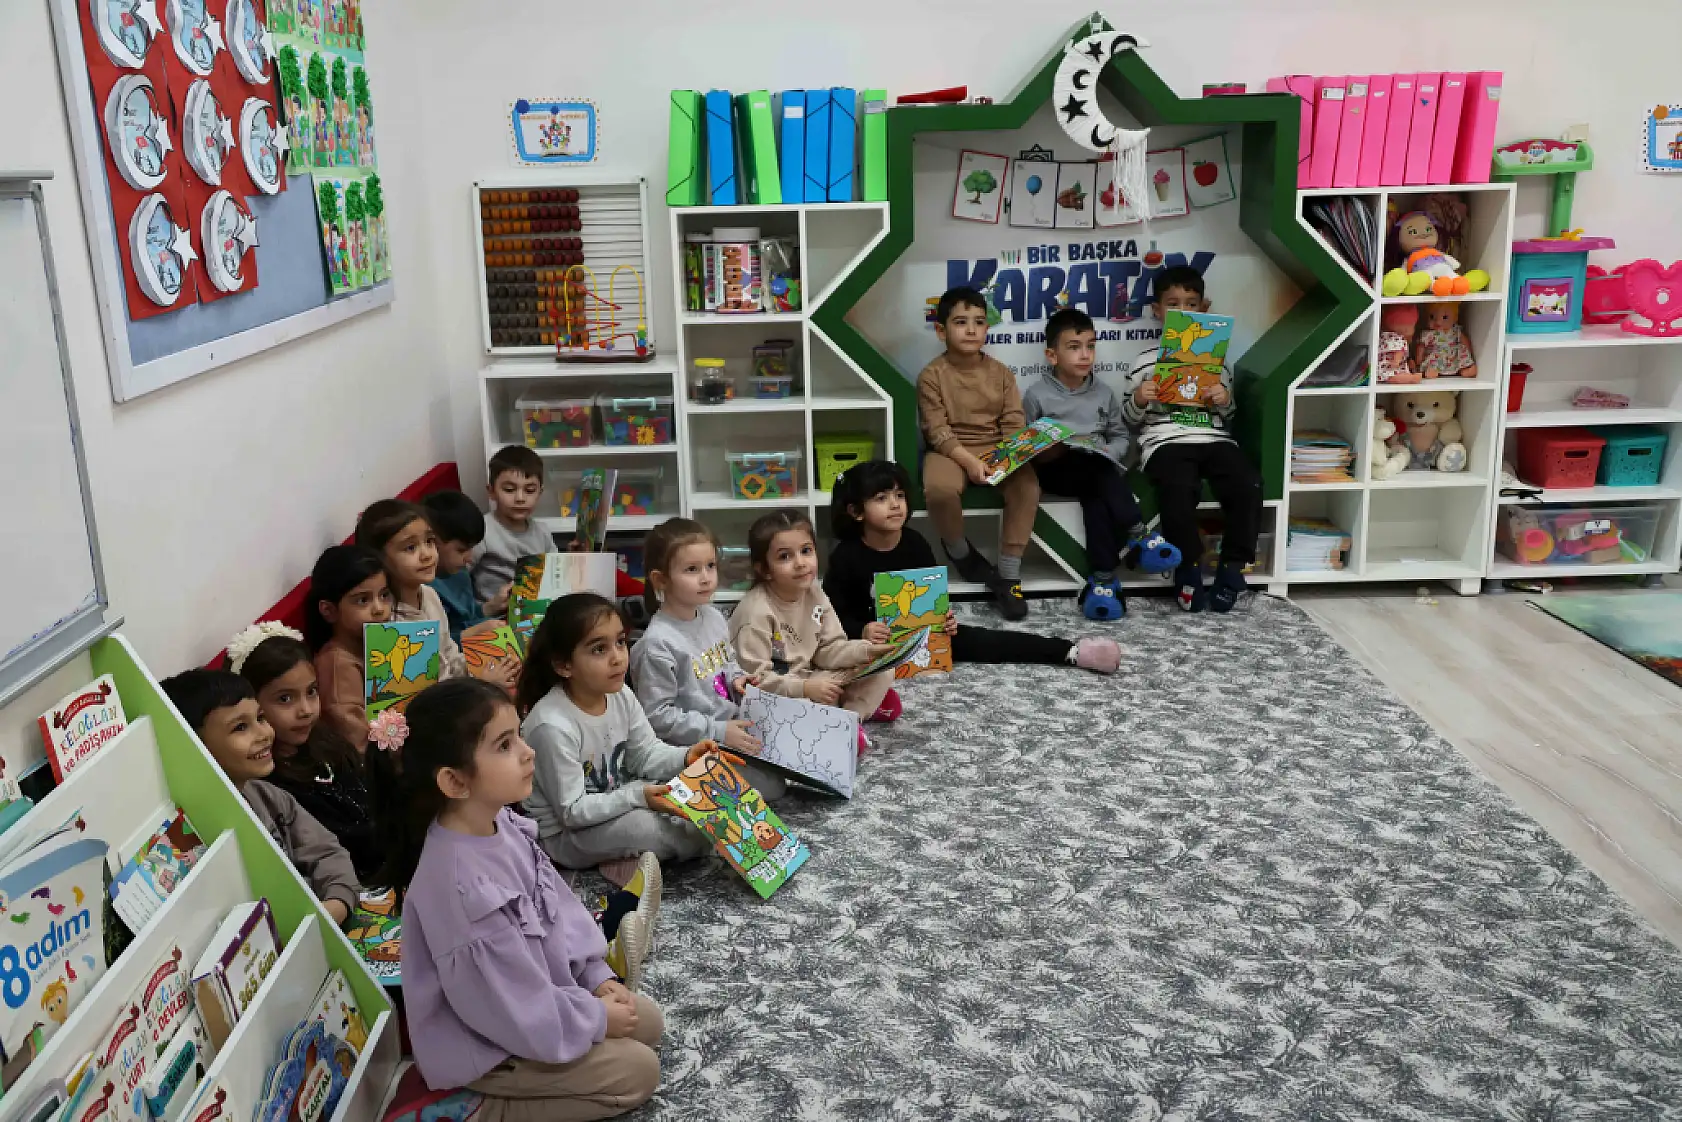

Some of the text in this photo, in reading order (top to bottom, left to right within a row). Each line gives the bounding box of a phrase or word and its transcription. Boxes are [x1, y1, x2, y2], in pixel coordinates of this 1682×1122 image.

[1027, 238, 1138, 264] BİR BAŞKA
[1095, 329, 1121, 341] LARI
[1125, 328, 1163, 341] KİTAP
[0, 944, 32, 1010] 8
[25, 908, 91, 971] adım
[145, 969, 188, 1030] ELOĞLAN
[158, 990, 189, 1032] DEVLER
